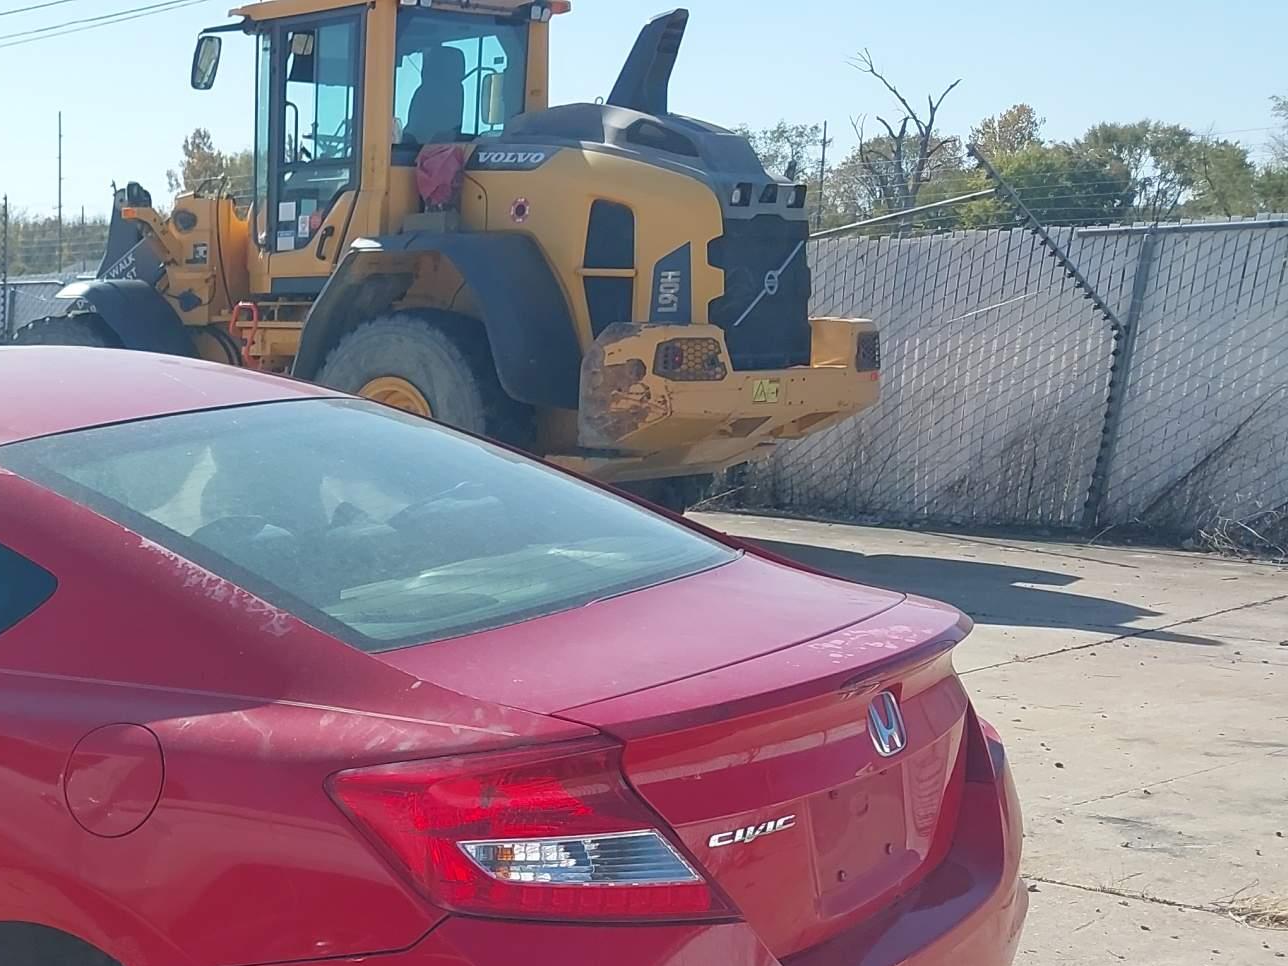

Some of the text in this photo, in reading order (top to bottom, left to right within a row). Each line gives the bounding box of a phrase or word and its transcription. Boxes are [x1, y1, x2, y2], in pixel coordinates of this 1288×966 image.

[478, 151, 545, 163] VOLVO
[109, 253, 136, 278] WALK
[657, 270, 681, 313] L90H
[708, 814, 797, 848] CIVIC
